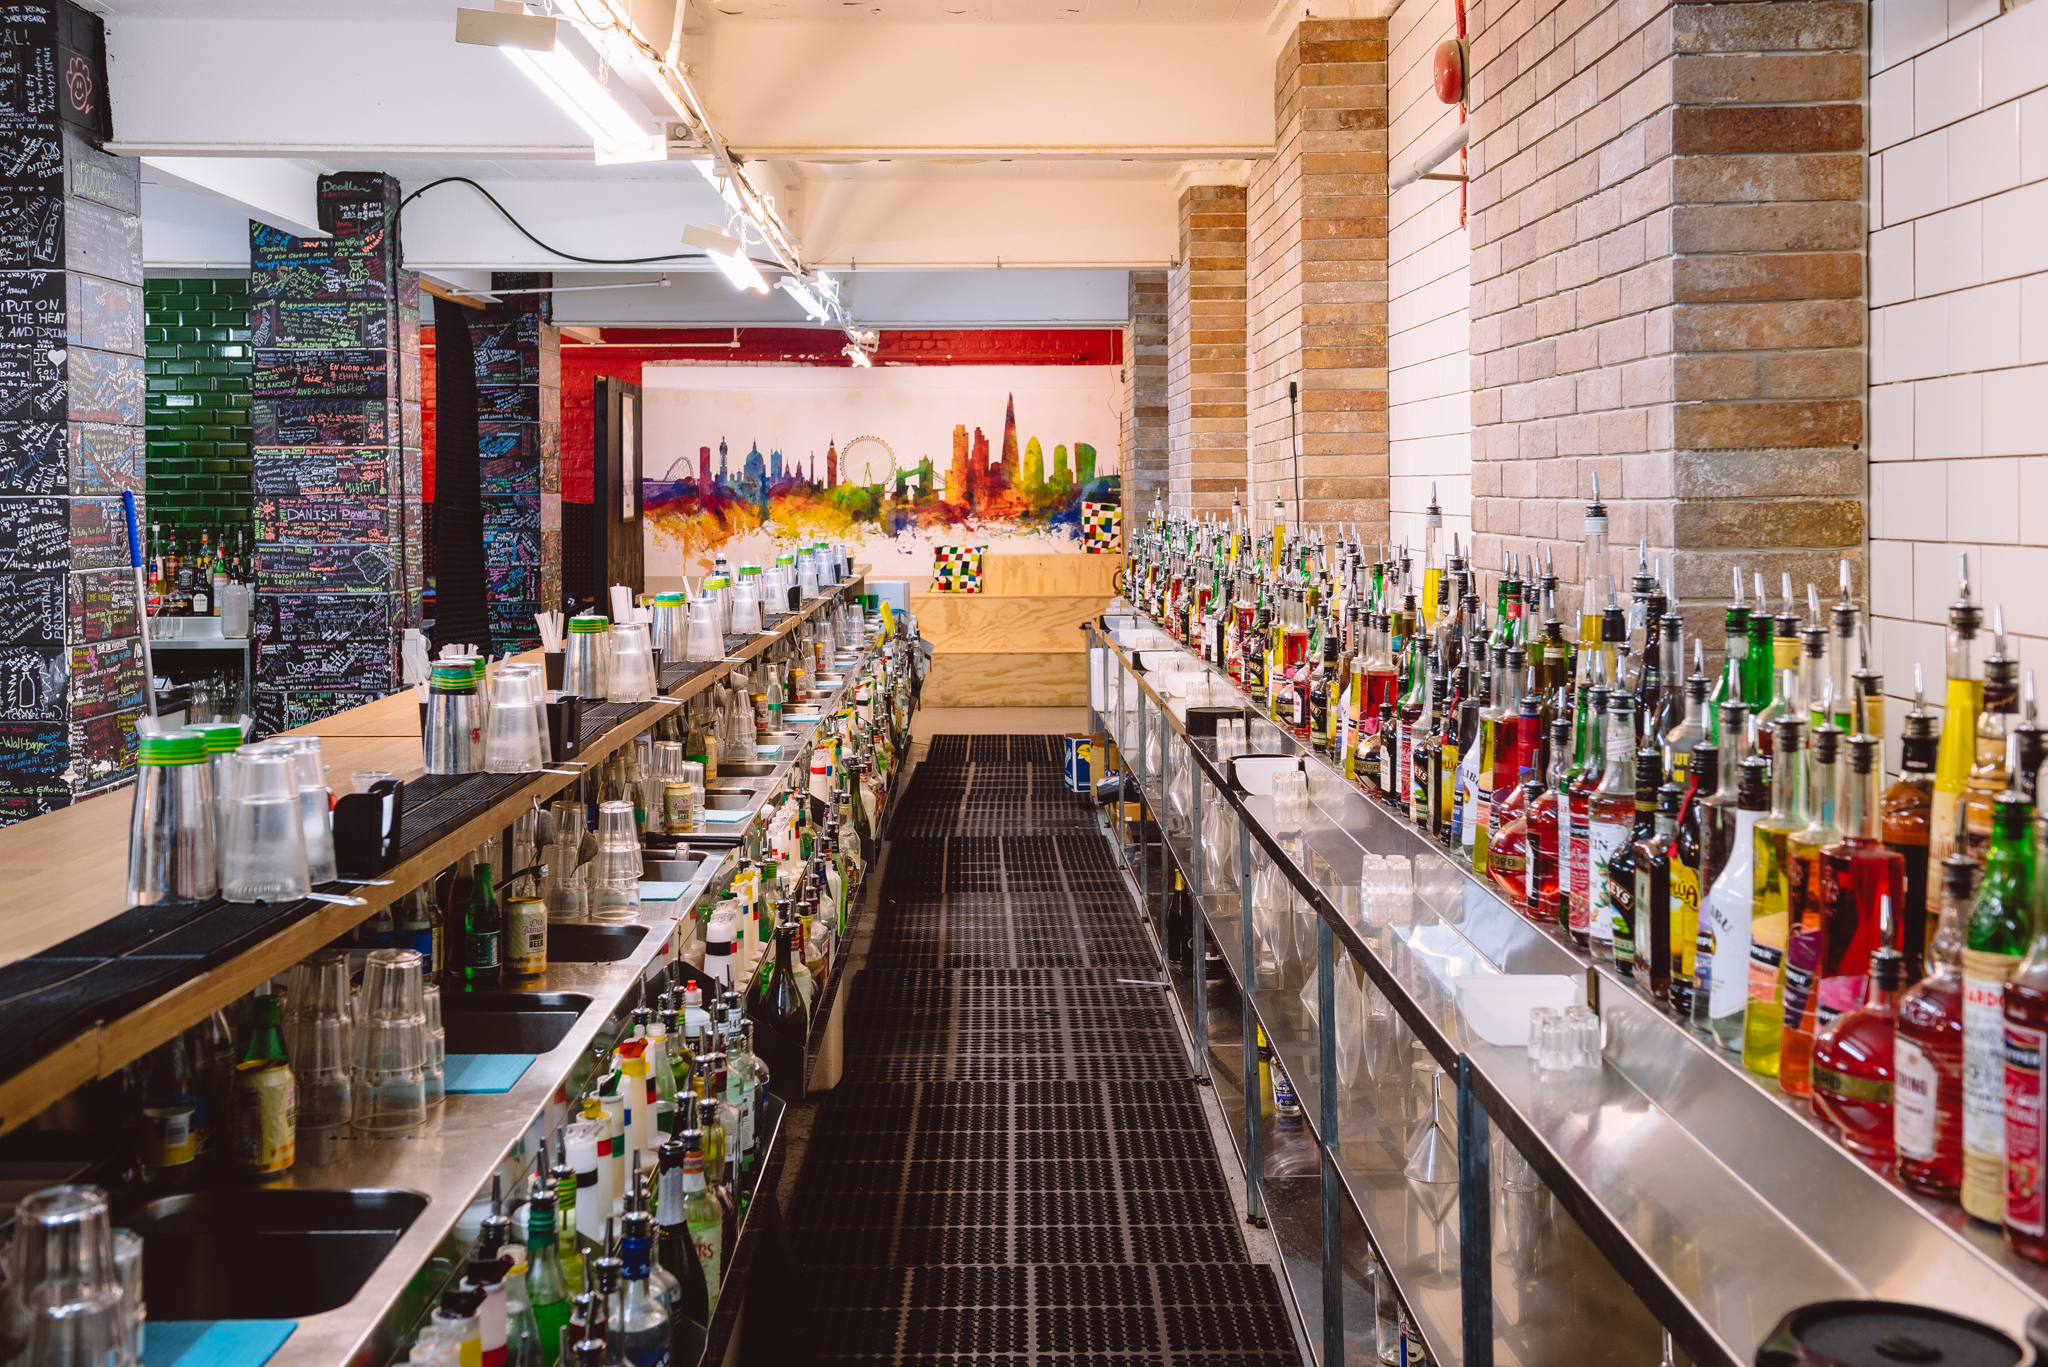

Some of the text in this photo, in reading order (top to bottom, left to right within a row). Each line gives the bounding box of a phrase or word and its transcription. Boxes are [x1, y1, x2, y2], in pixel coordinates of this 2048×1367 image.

[43, 47, 56, 111] ALWAYS RIGHT
[27, 90, 38, 113] RULE
[27, 160, 51, 174] BITCH
[38, 165, 64, 179] PLEASE
[27, 195, 47, 214] HAD
[36, 202, 62, 260] FEB 2013
[5, 299, 33, 313] PUT
[35, 298, 59, 311] ON
[5, 312, 66, 325] THE HEAT
[7, 326, 68, 339] AND DRINK
[34, 349, 48, 366] I
[299, 486, 323, 494] ITALIAN
[286, 508, 381, 521] DANISH POWER
[42, 582, 52, 640] COCKTAIL
[496, 604, 523, 613] ALLEZ
[53, 595, 64, 640] PRISON
[280, 624, 294, 633] NO
[297, 624, 314, 632] SEX
[1609, 879, 1631, 905] EYS
[529, 918, 544, 928] Old
[529, 940, 544, 949] BEER
